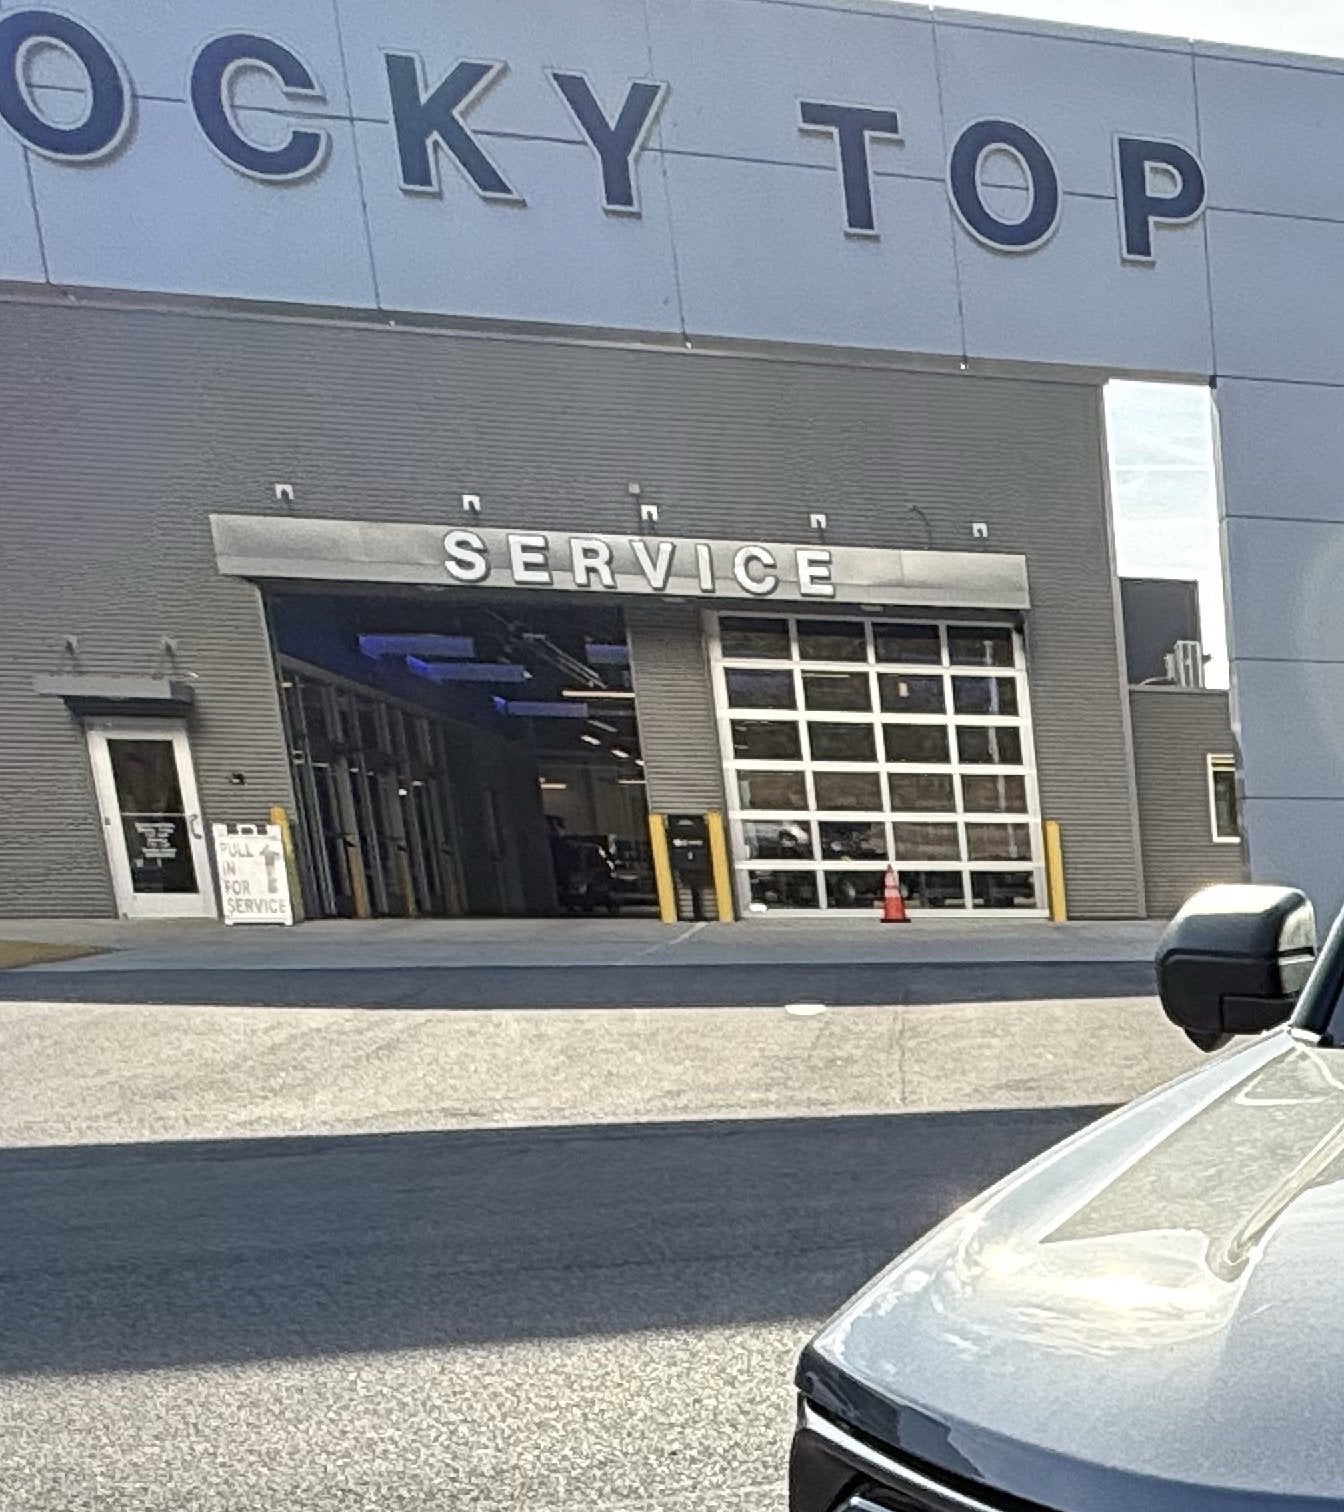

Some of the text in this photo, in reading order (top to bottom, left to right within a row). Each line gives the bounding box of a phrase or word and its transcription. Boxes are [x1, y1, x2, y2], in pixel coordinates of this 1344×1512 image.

[0, 9, 1207, 262] OCKY TOP
[443, 530, 835, 597] SERVICE
[220, 842, 254, 858] PULL
[222, 861, 236, 877] IN
[225, 880, 250, 895] FOR
[228, 898, 287, 914] SERVICE
